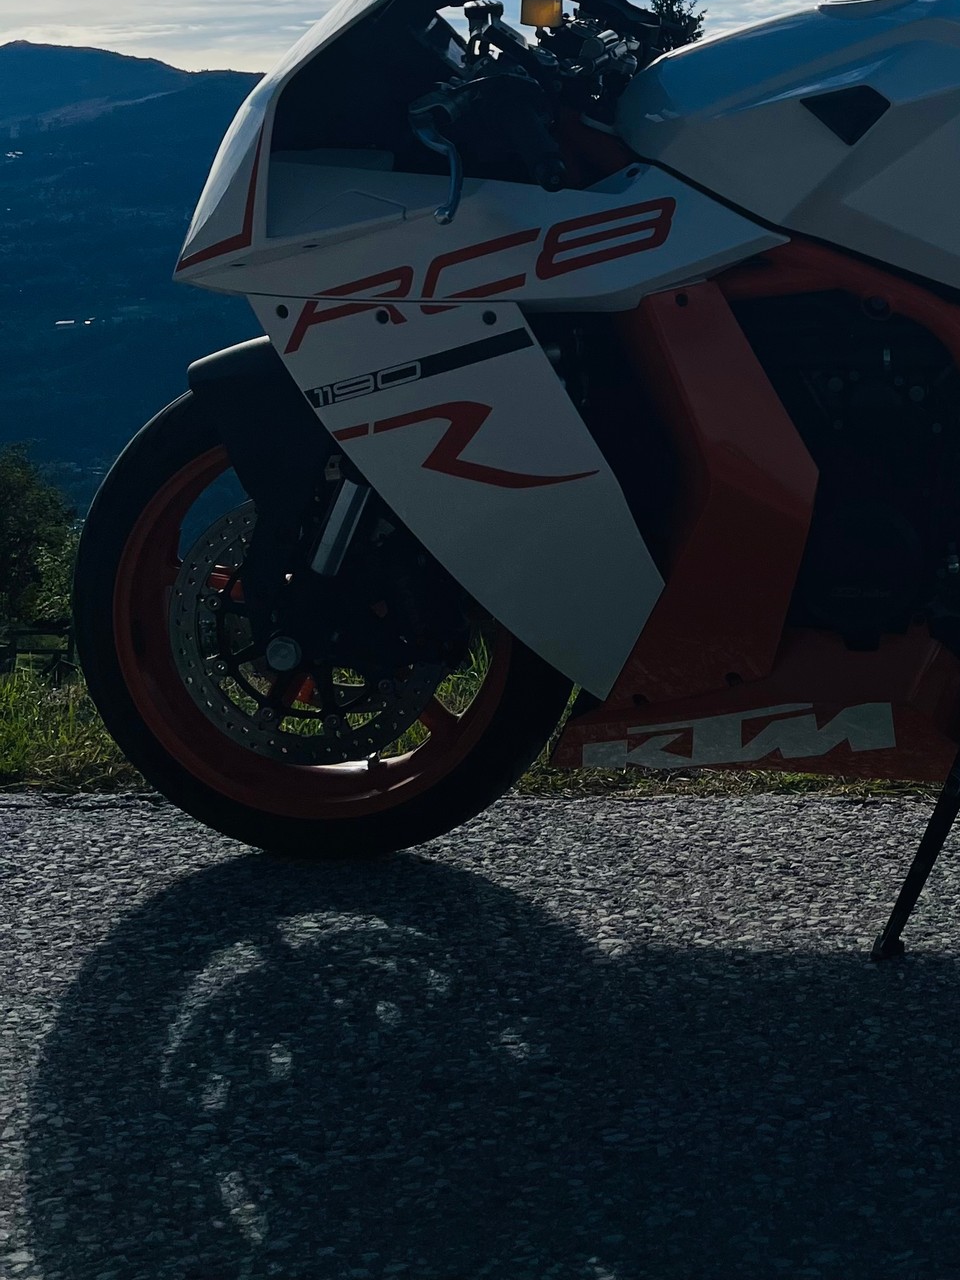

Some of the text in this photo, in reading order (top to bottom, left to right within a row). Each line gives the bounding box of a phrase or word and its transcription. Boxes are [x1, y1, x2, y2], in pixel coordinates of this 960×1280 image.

[284, 196, 676, 353] RC8
[314, 361, 421, 406] 1190
[582, 702, 896, 768] KTM
